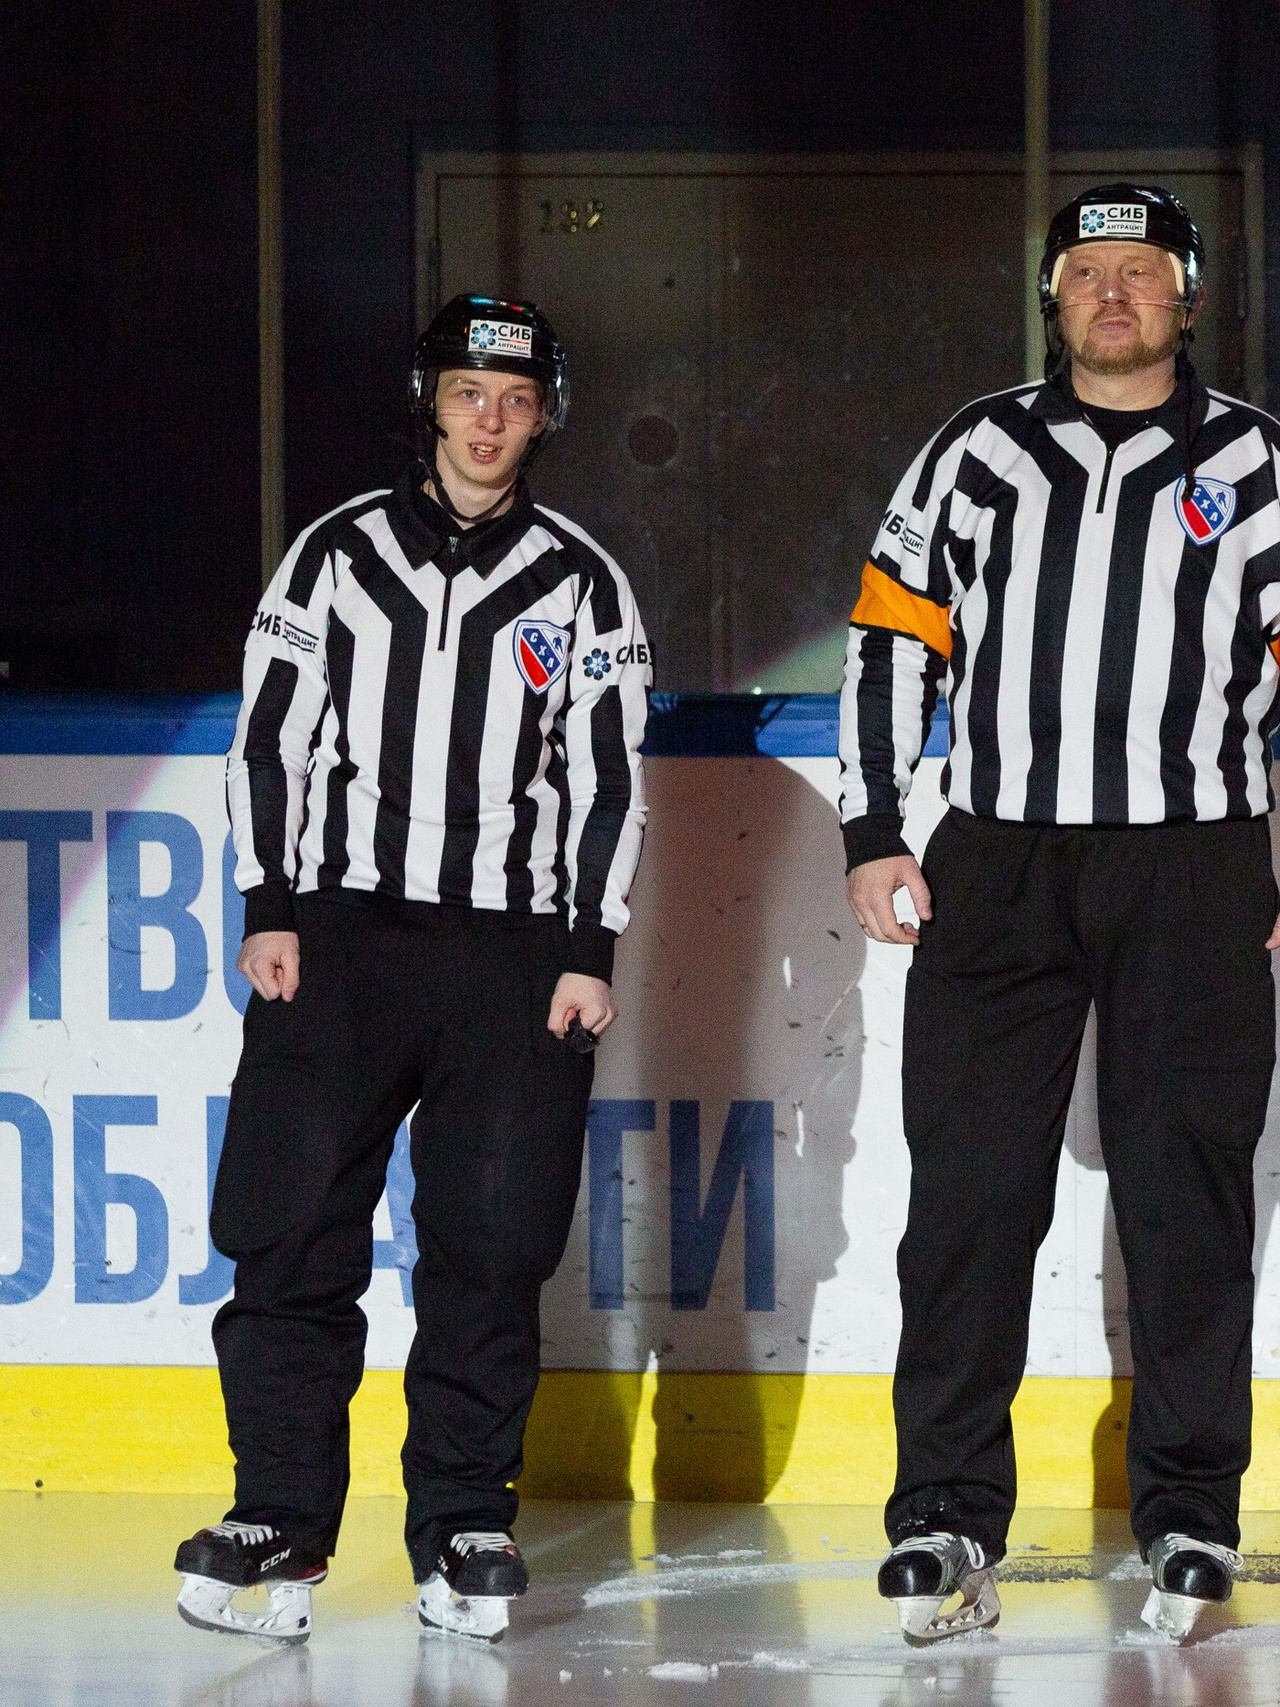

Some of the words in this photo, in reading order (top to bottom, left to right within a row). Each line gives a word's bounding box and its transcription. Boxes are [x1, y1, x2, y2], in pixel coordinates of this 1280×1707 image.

[1107, 207, 1144, 219] СИБ
[498, 324, 531, 341] СИБ
[260, 1547, 292, 1572] CCM
